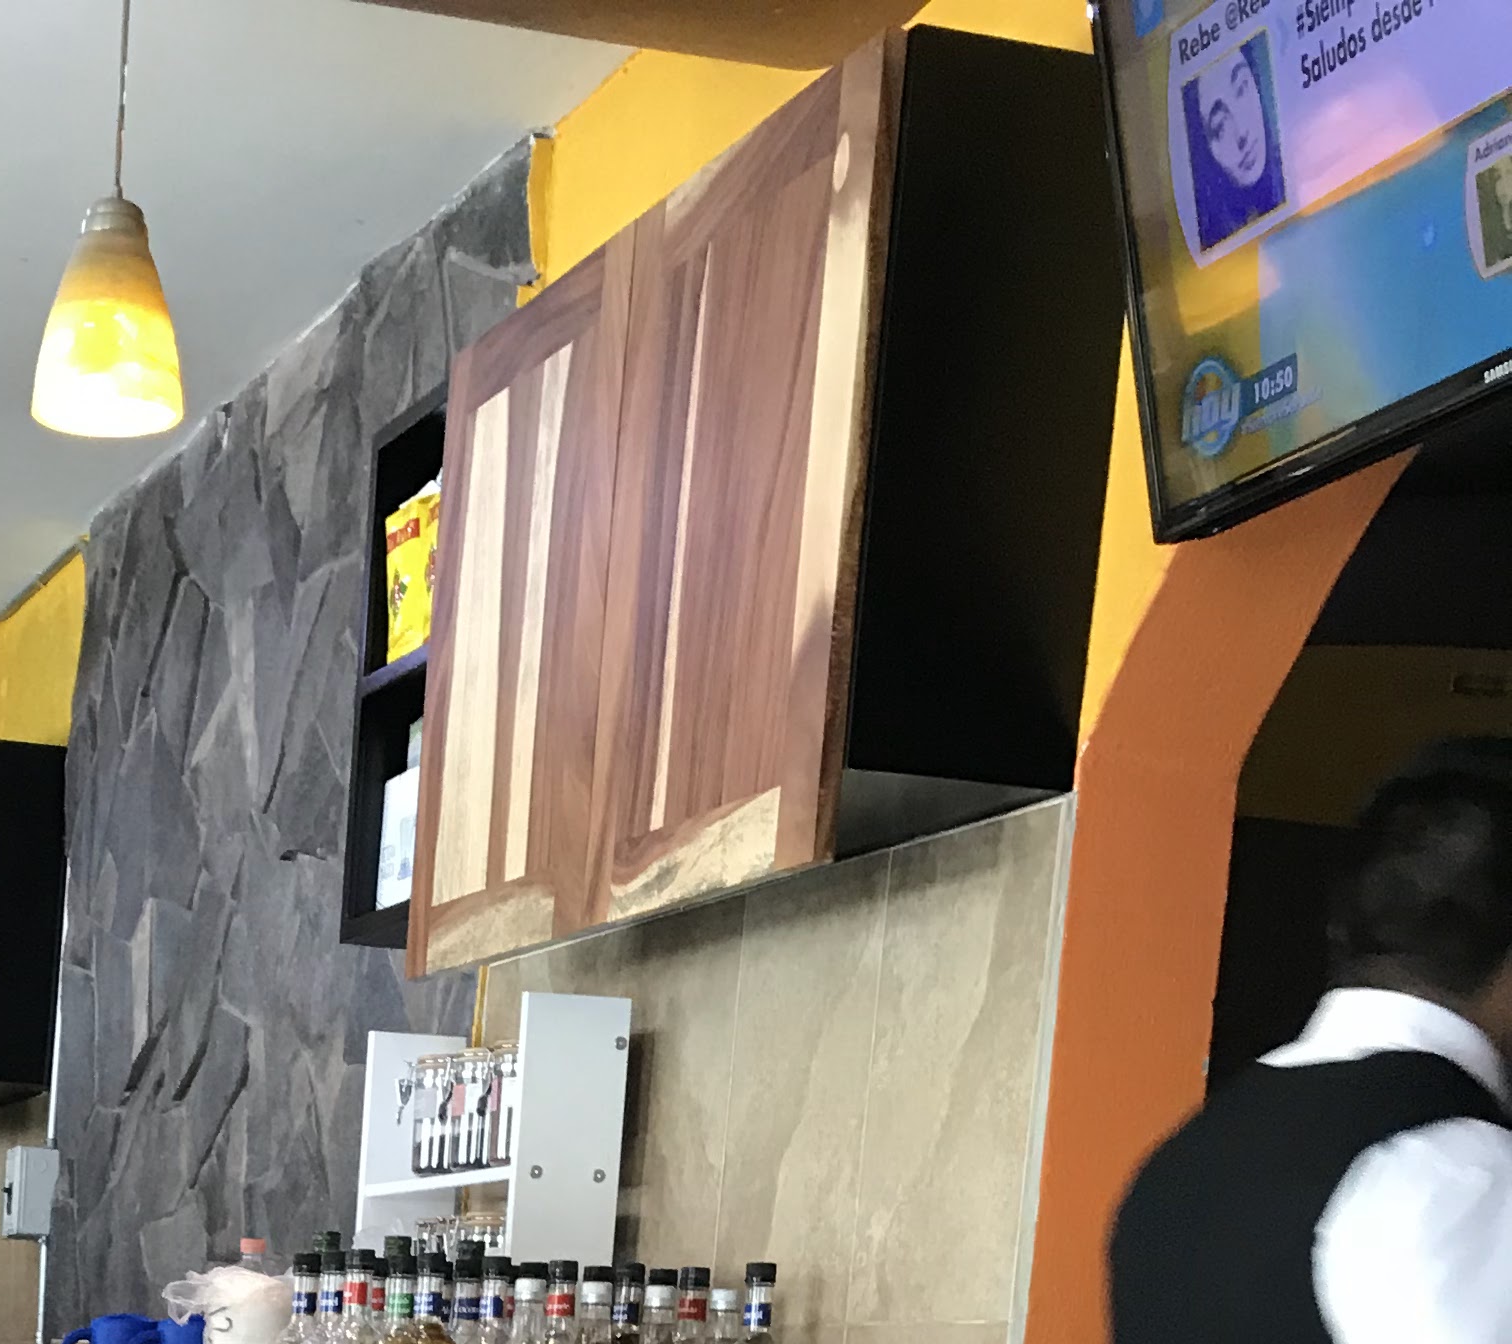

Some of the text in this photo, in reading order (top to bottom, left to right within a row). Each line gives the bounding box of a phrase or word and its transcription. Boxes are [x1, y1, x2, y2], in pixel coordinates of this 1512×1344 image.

[1178, 23, 1221, 65] Rebe
[1301, 0, 1423, 89] Saludos desde
[1254, 366, 1294, 404] 10:50
